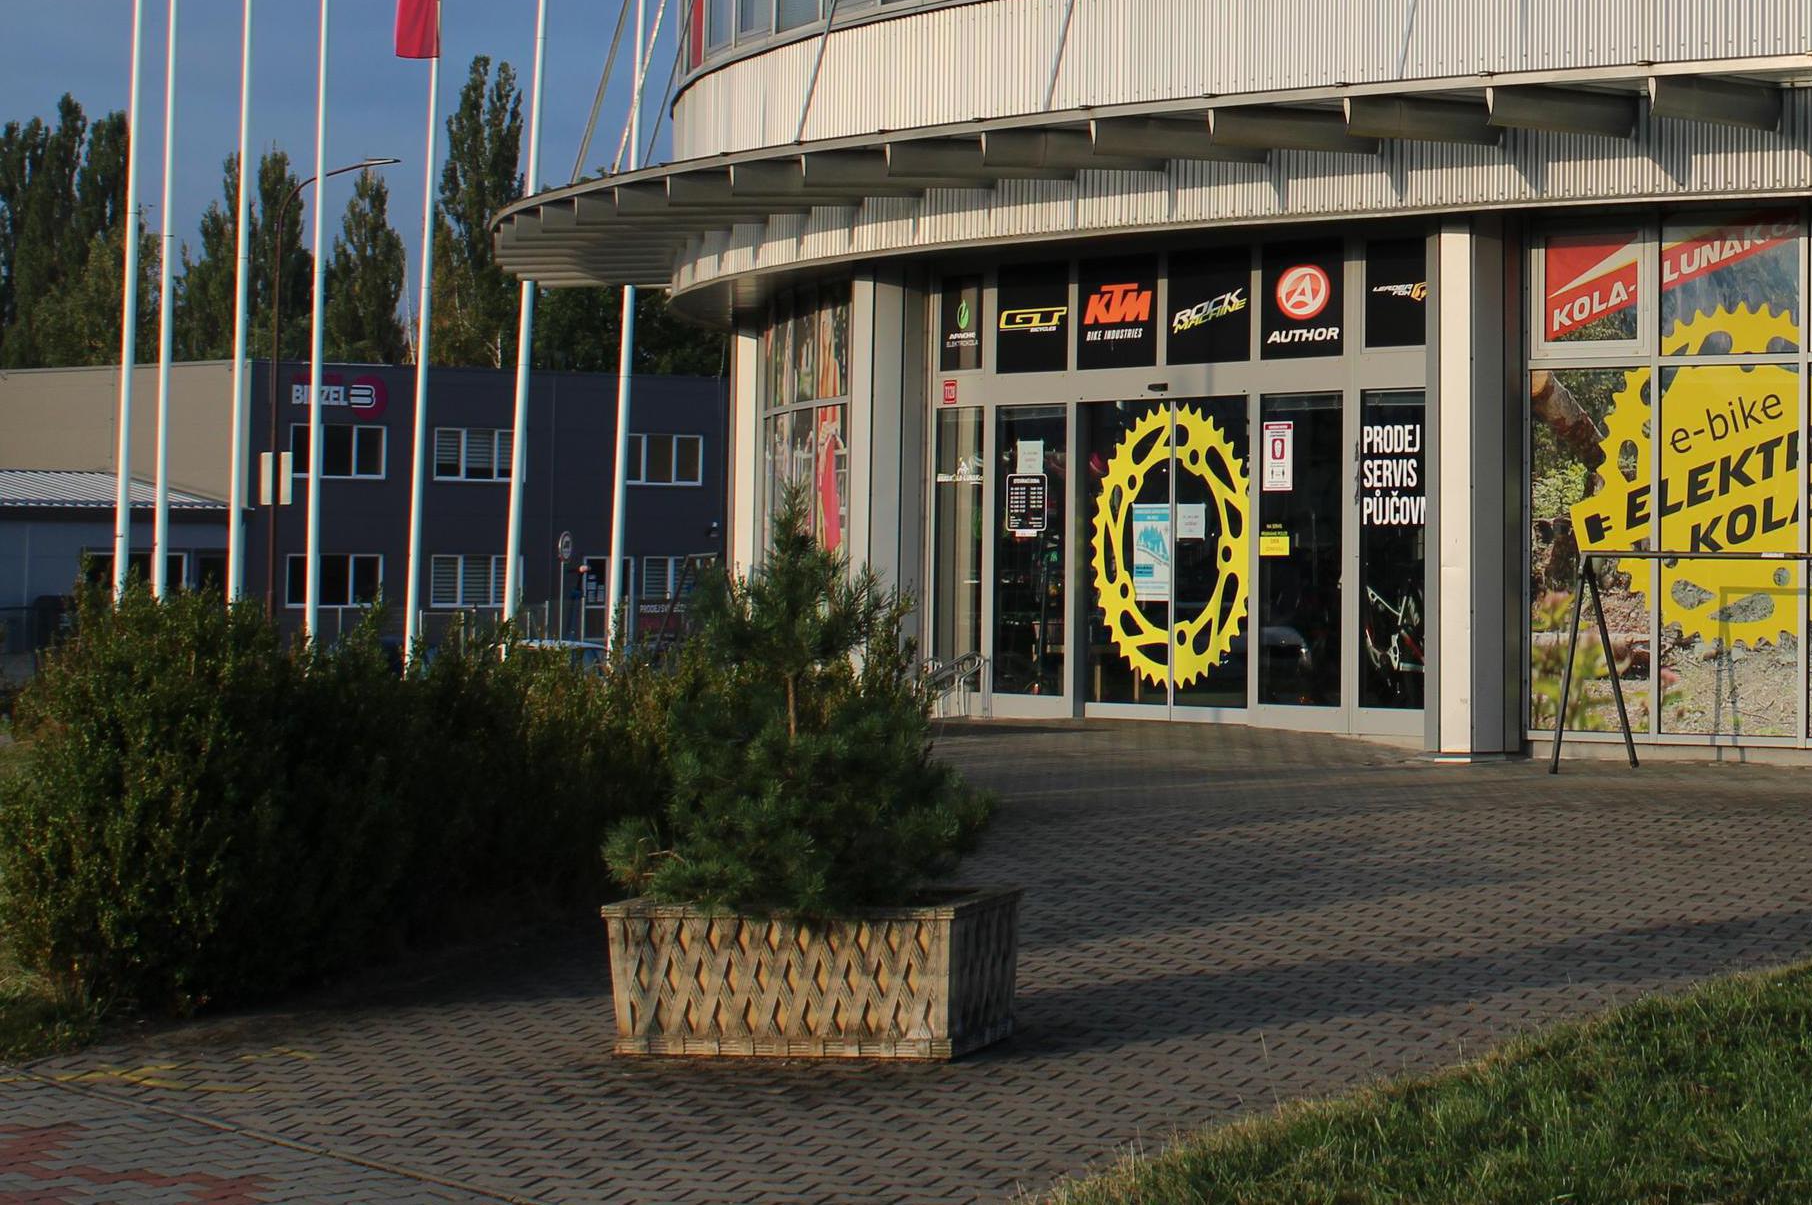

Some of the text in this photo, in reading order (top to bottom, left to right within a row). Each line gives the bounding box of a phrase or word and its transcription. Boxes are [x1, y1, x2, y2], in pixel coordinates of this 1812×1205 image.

[999, 306, 1067, 329] GT
[1083, 283, 1152, 325] KTM
[1173, 288, 1243, 327] ROCK
[1173, 297, 1247, 334] MACHINE
[1086, 327, 1143, 342] BIKE INDUSTRIES
[1267, 327, 1340, 344] AUTHOR
[291, 384, 349, 406] BIZEL
[1670, 393, 1783, 454] e-bike
[1363, 424, 1421, 453] PRODEJ
[1363, 459, 1418, 488] SERVIS
